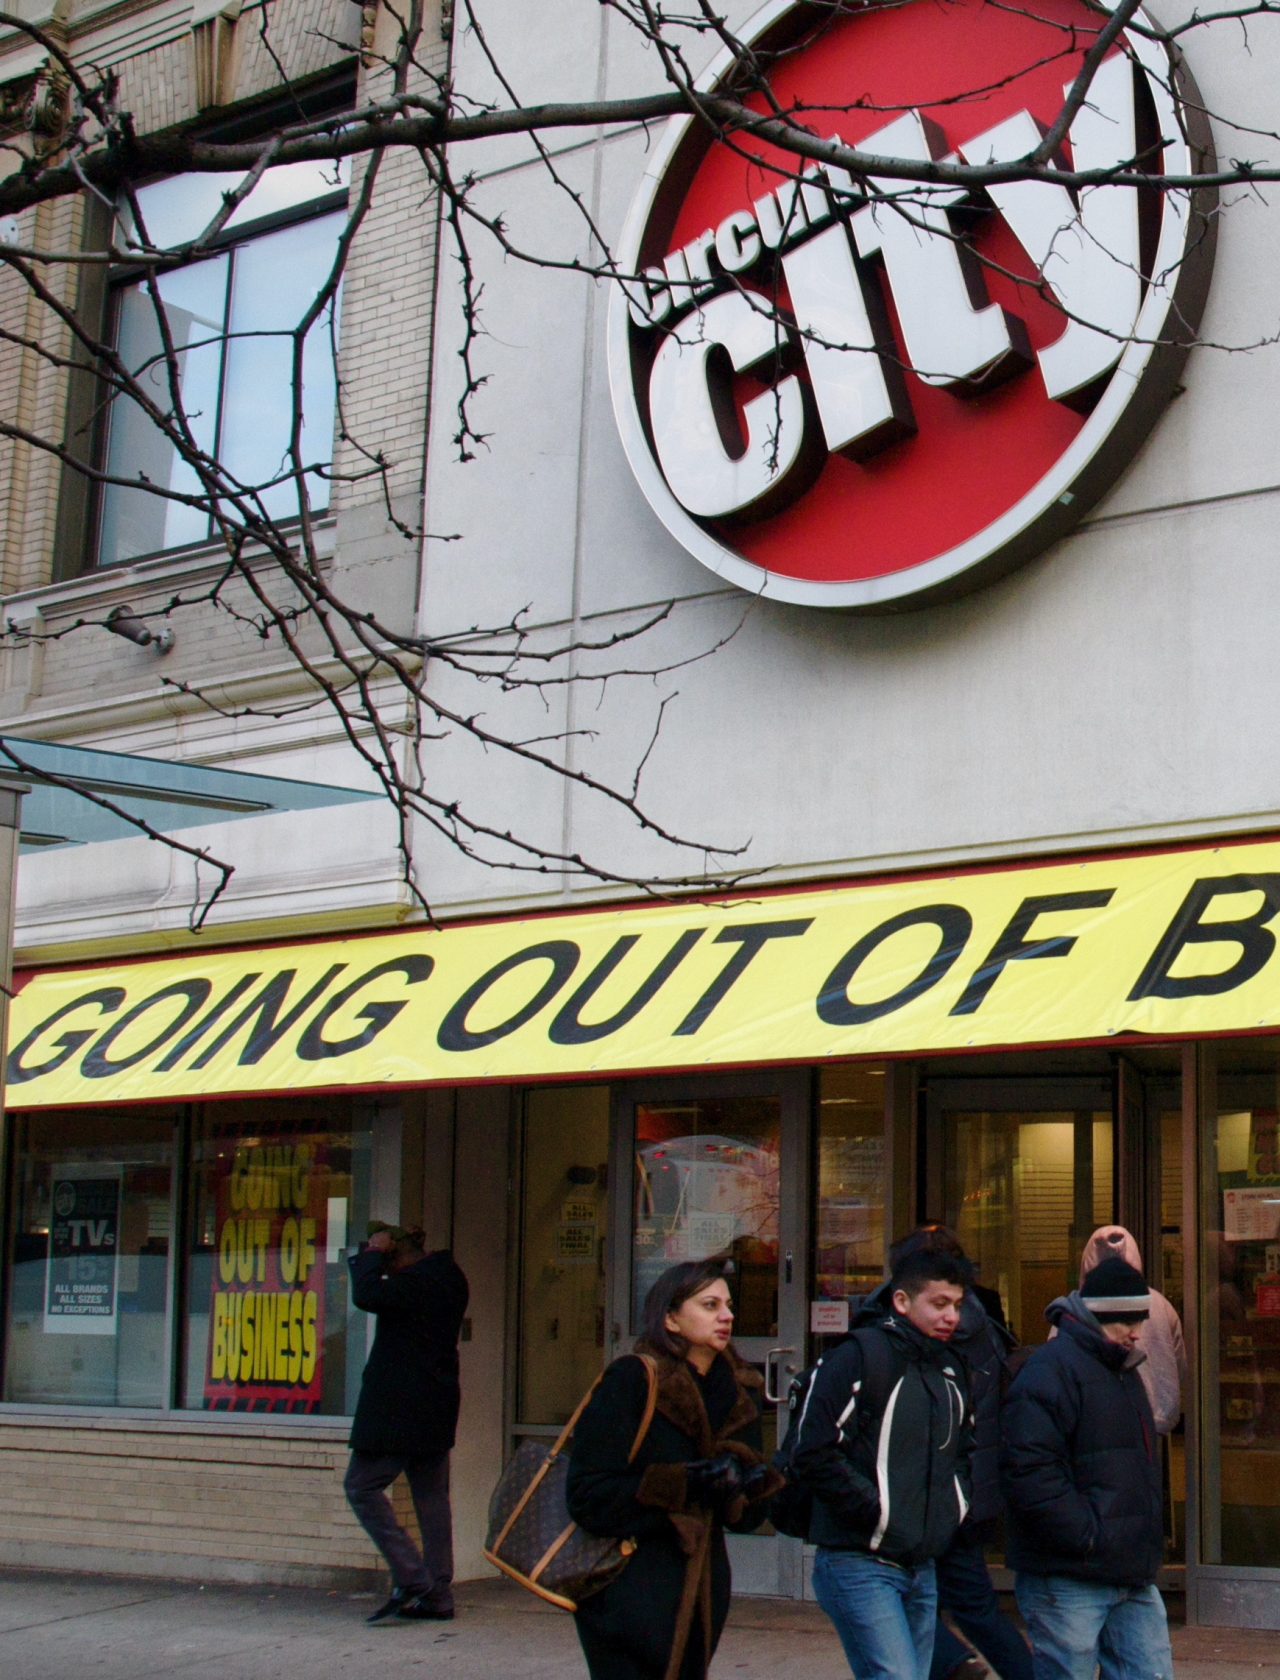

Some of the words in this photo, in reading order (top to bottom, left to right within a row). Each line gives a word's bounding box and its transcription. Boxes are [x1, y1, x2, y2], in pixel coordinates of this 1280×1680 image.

[5, 953, 435, 1084] GOING
[437, 917, 815, 1052] OUT
[816, 887, 1117, 1026] OF
[68, 1219, 115, 1246] TVs
[219, 1218, 271, 1284] OUT
[280, 1218, 318, 1284] OF
[55, 1284, 71, 1293] ALL
[73, 1284, 108, 1293] BRANDS
[60, 1294, 76, 1303] ALL
[78, 1294, 102, 1303] SIZES
[51, 1305, 62, 1313] NO
[211, 1291, 318, 1384] BUSINESS
